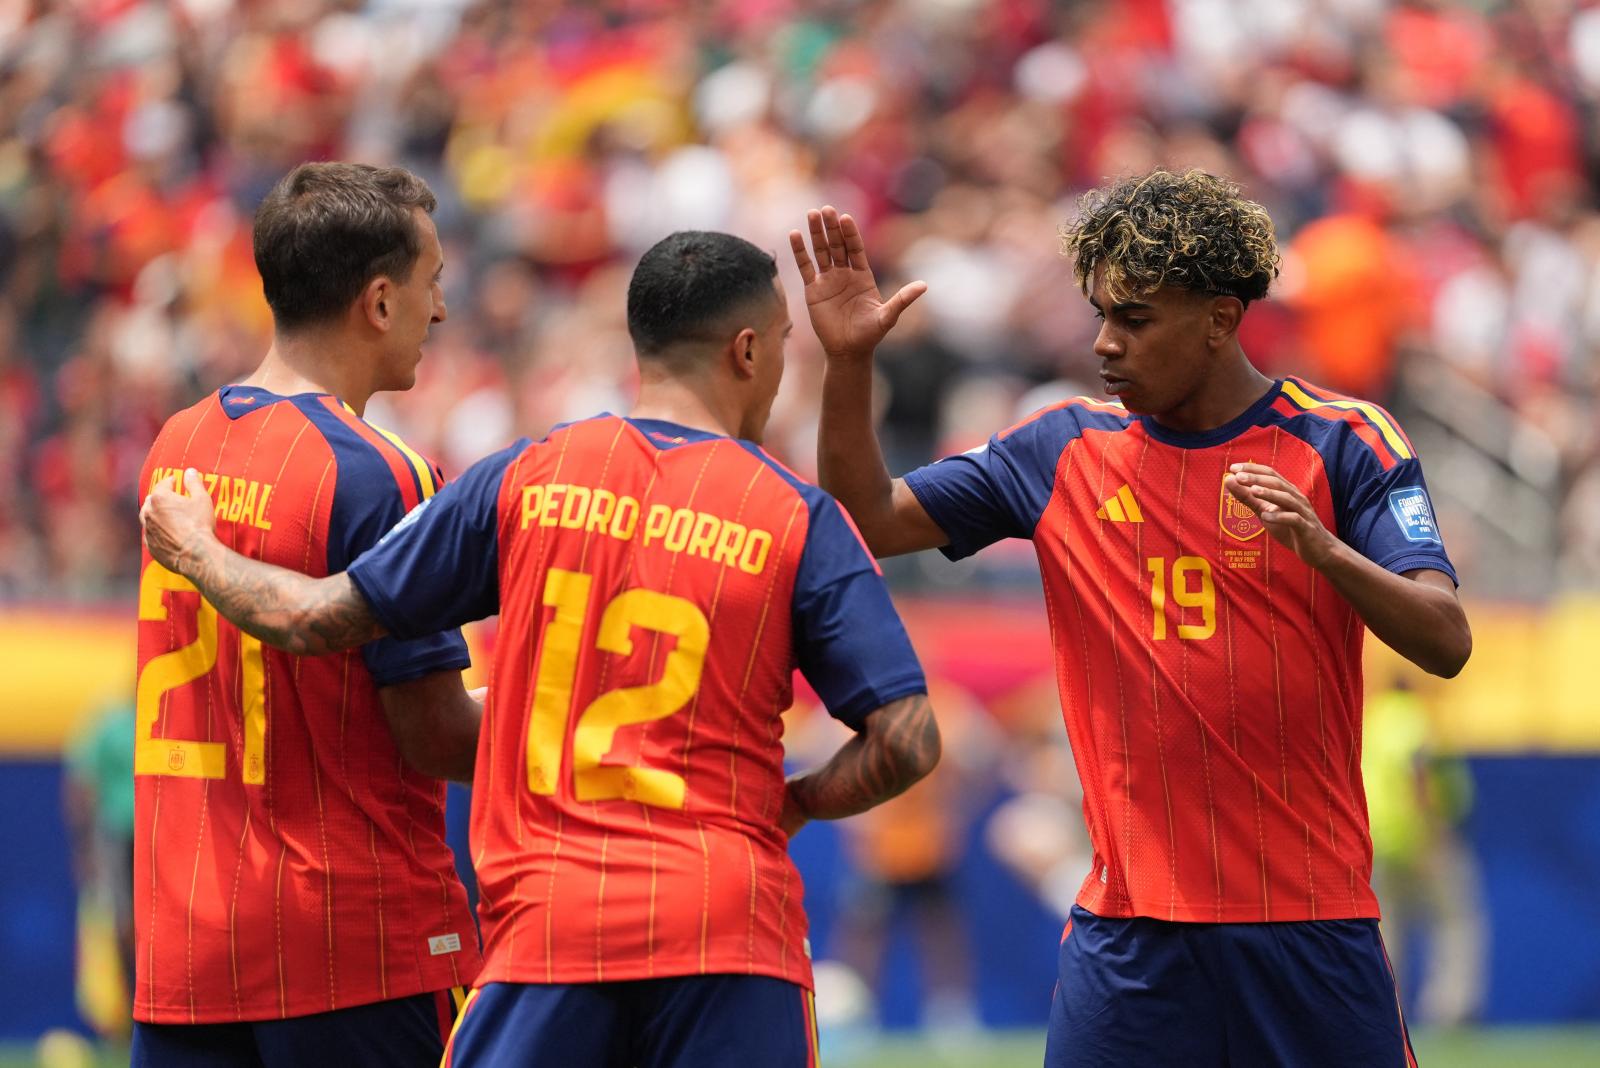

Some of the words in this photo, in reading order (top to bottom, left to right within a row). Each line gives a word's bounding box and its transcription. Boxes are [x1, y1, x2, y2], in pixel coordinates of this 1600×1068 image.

[149, 467, 272, 530] OAZABAL
[521, 484, 640, 541] PEDRO
[643, 504, 772, 575] PORRO
[1147, 555, 1217, 640] 19
[134, 559, 266, 784] 21
[526, 567, 710, 809] 12
